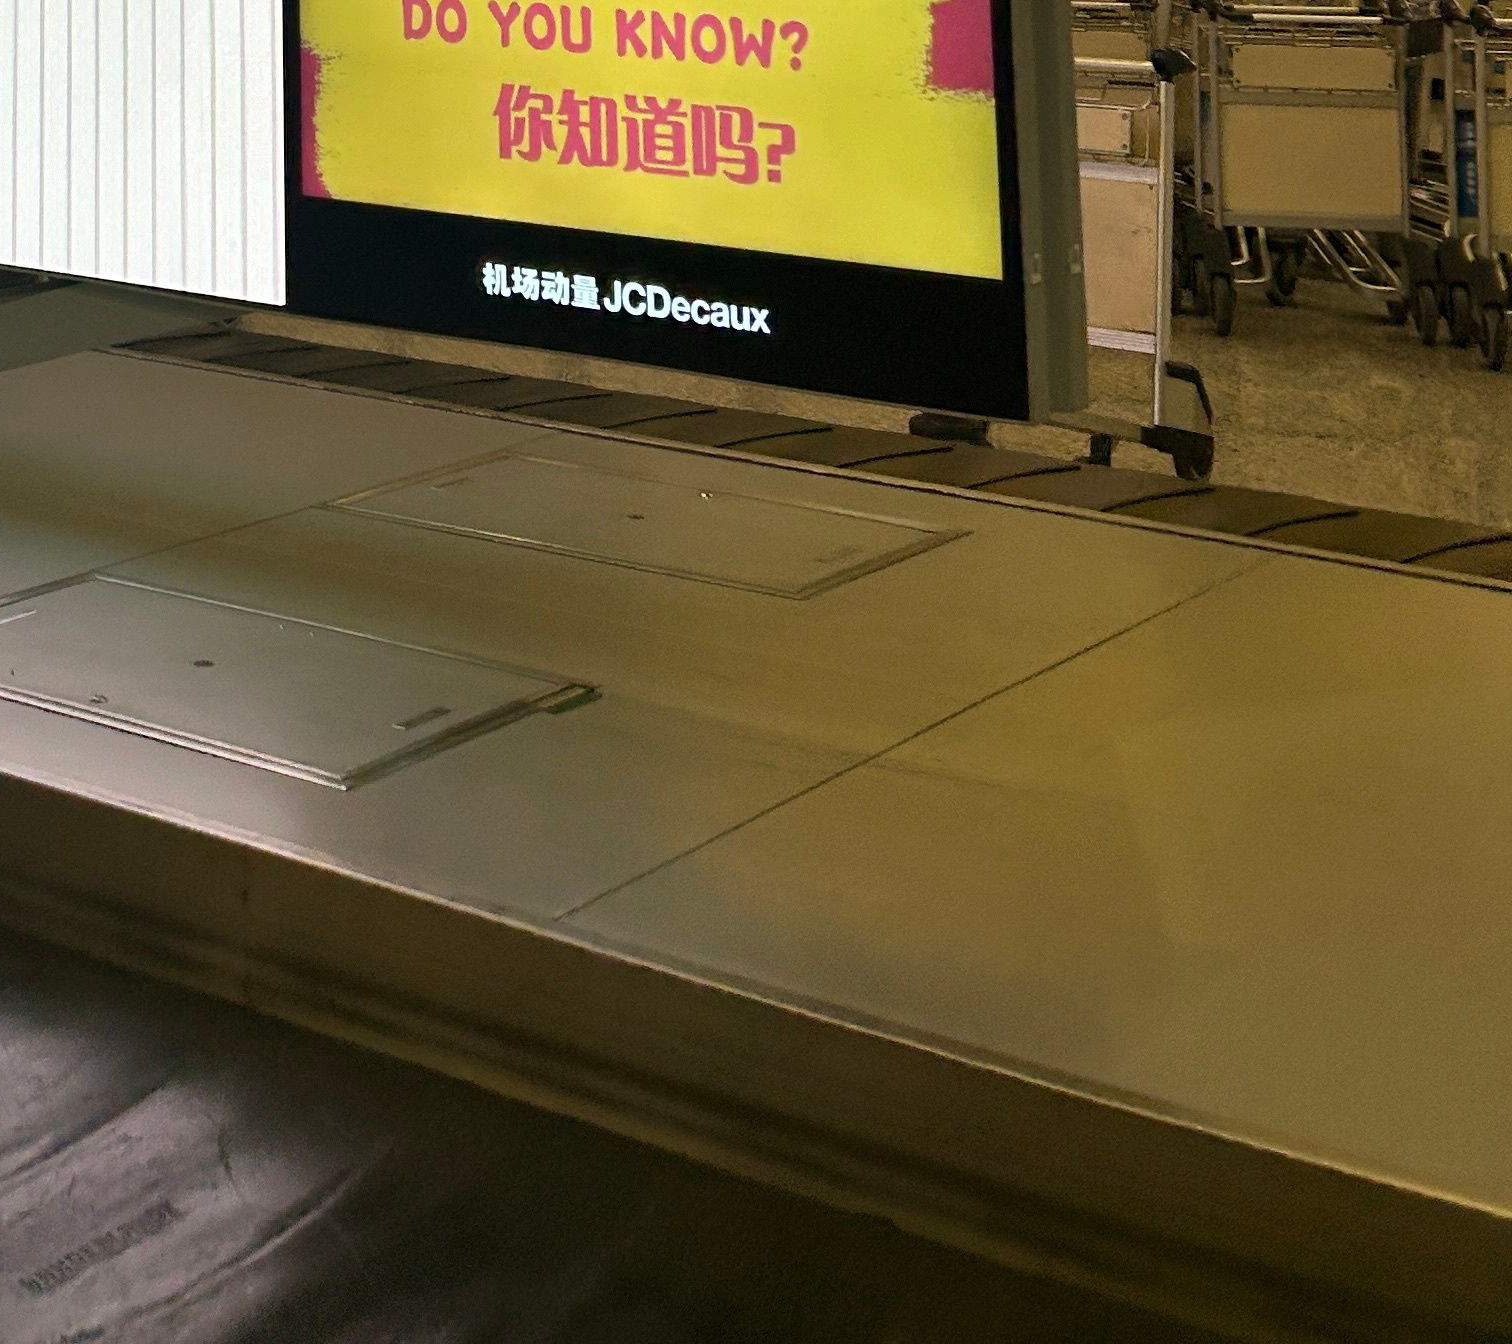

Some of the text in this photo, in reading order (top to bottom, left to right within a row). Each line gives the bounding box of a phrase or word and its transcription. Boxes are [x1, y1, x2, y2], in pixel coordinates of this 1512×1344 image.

[489, 0, 592, 54] YOU
[616, 11, 809, 72] KNOW?
[493, 82, 797, 185] 你知道吗?
[482, 261, 772, 334] 机场动量 JCDecaux
